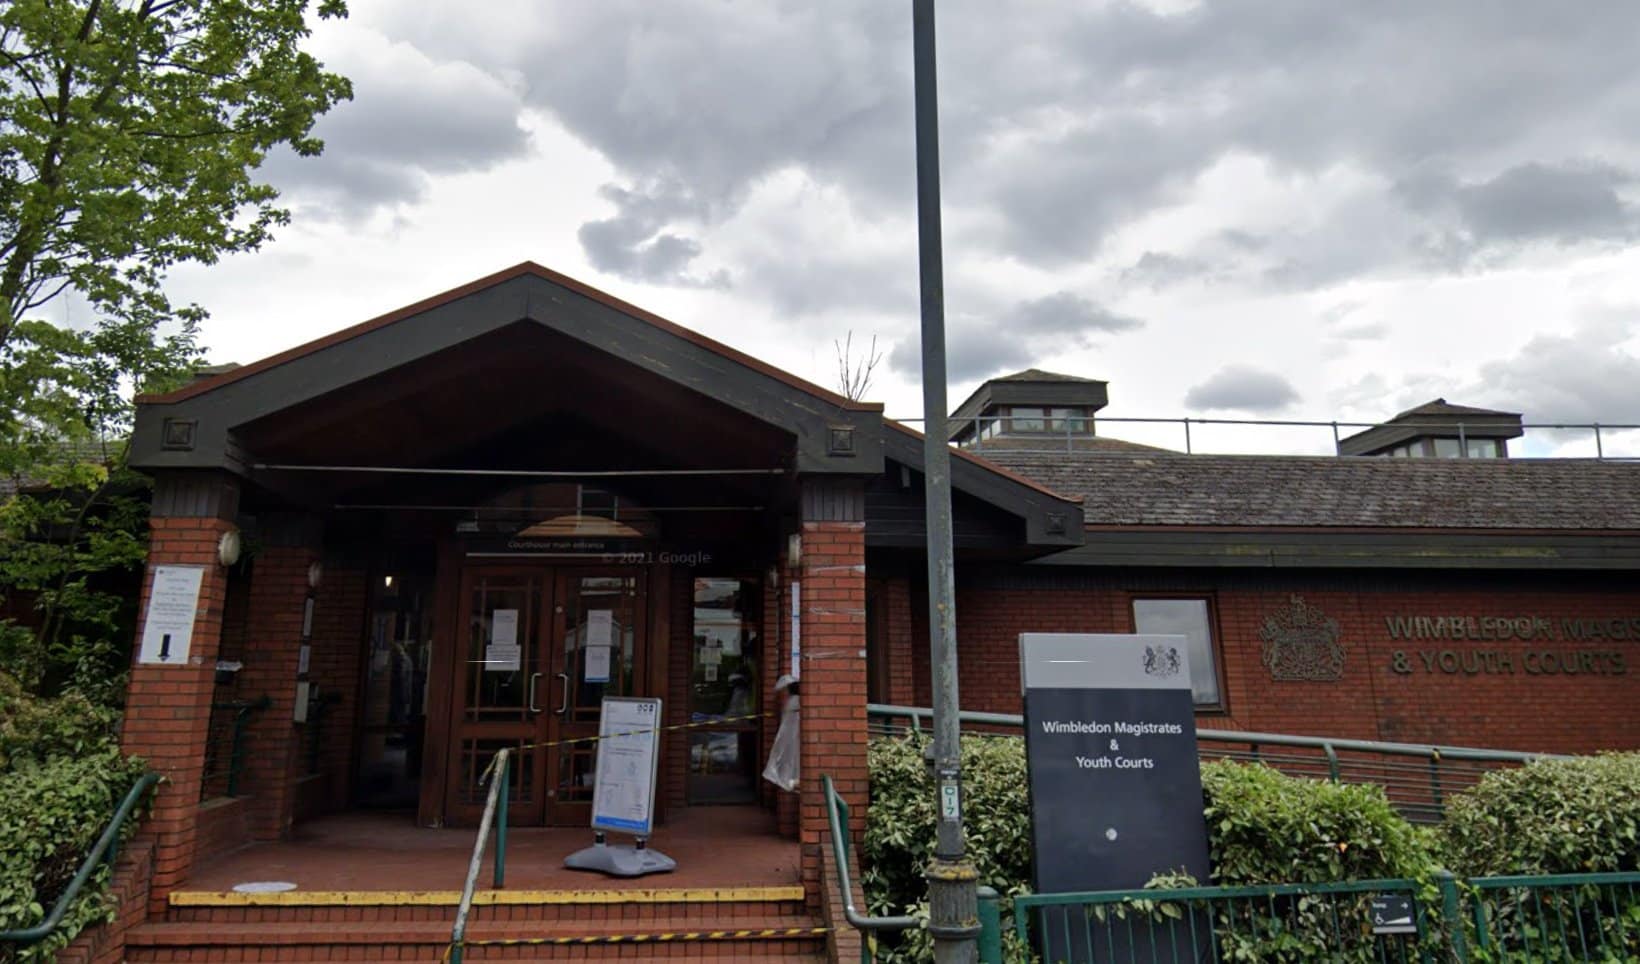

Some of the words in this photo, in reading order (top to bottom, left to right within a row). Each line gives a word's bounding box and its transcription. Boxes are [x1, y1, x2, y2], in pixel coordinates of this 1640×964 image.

[1385, 616, 1553, 640] WIMBLEDON
[1392, 650, 1413, 674] &
[1419, 650, 1515, 674] YOUTH
[1521, 651, 1627, 675] COURTS
[1042, 720, 1112, 734] Wimbledon
[1114, 721, 1183, 737] Magistrates
[1109, 739, 1119, 751] &
[1075, 756, 1113, 769] Youth
[1114, 756, 1154, 769] Courts
